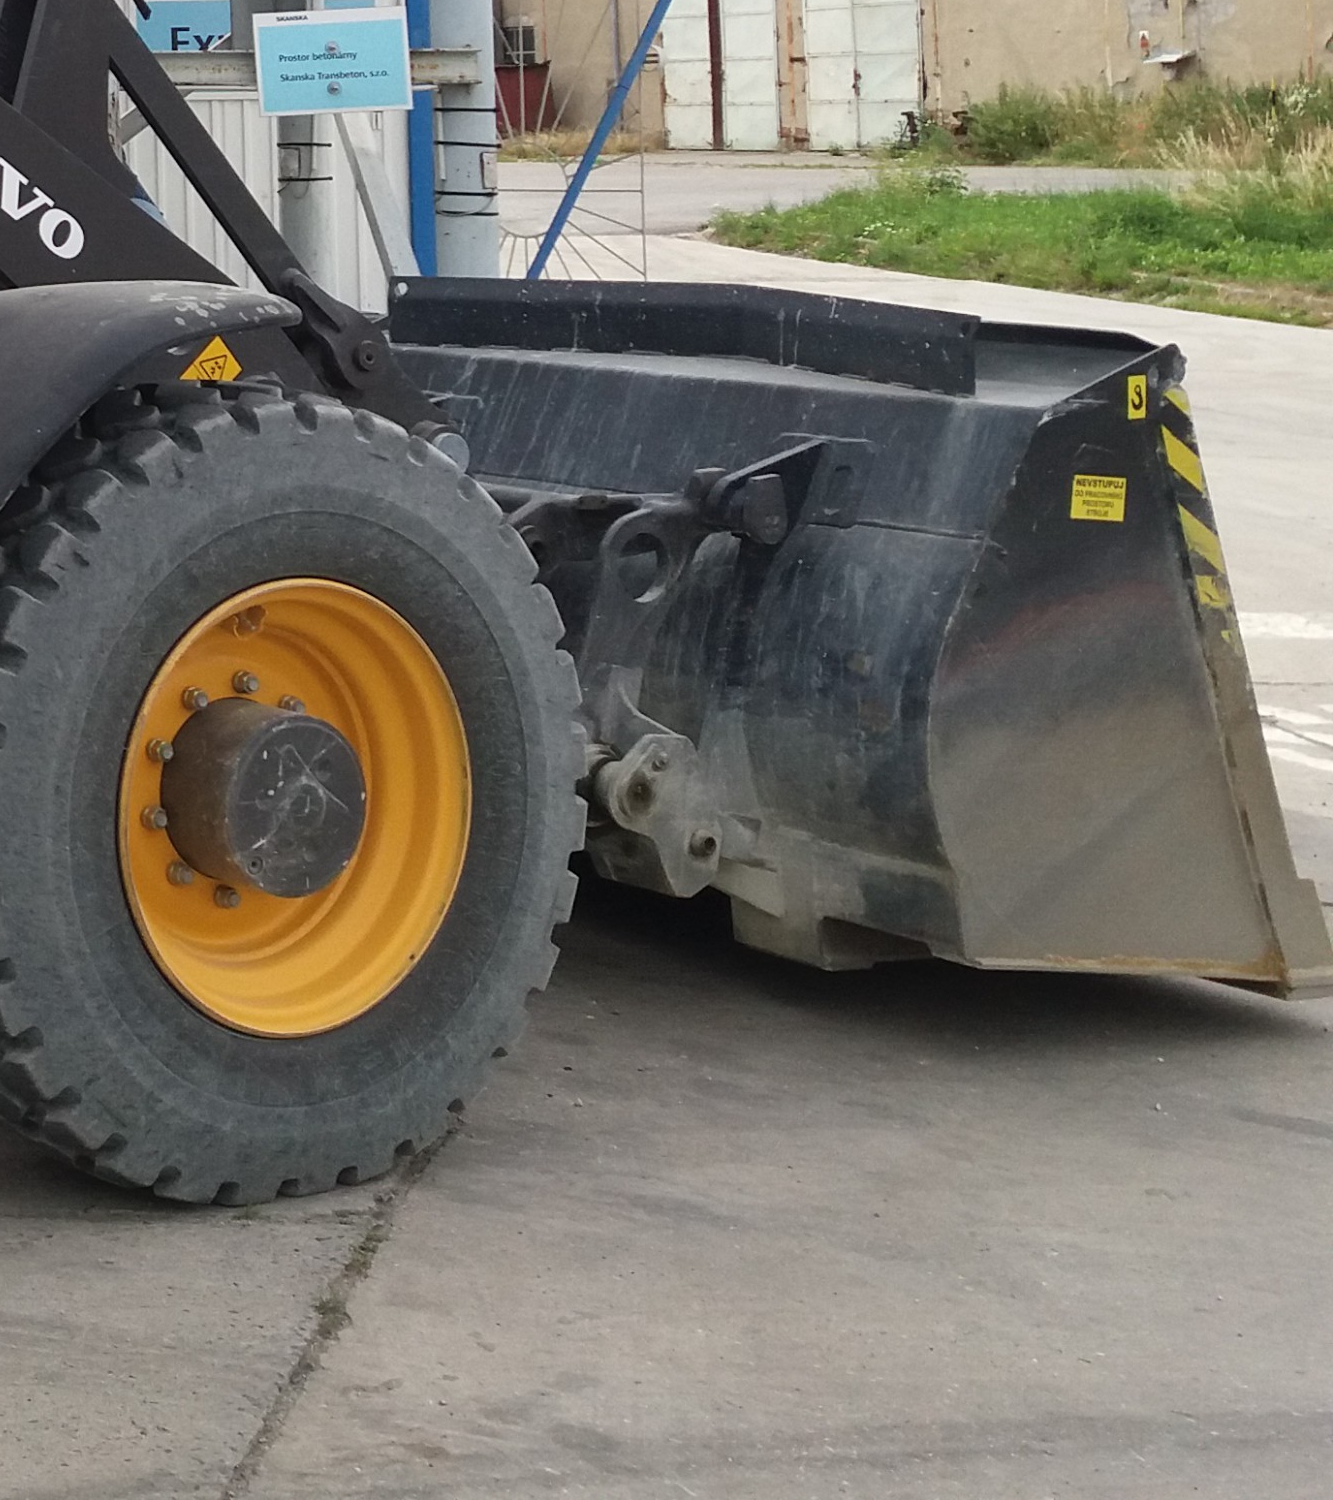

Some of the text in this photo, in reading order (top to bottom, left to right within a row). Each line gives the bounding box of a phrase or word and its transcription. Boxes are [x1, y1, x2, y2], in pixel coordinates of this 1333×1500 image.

[279, 52, 310, 62] Prostor
[280, 72, 315, 82] Skanska
[317, 70, 368, 81] Transbeton,
[1075, 478, 1124, 490] NEVSTUPUJ
